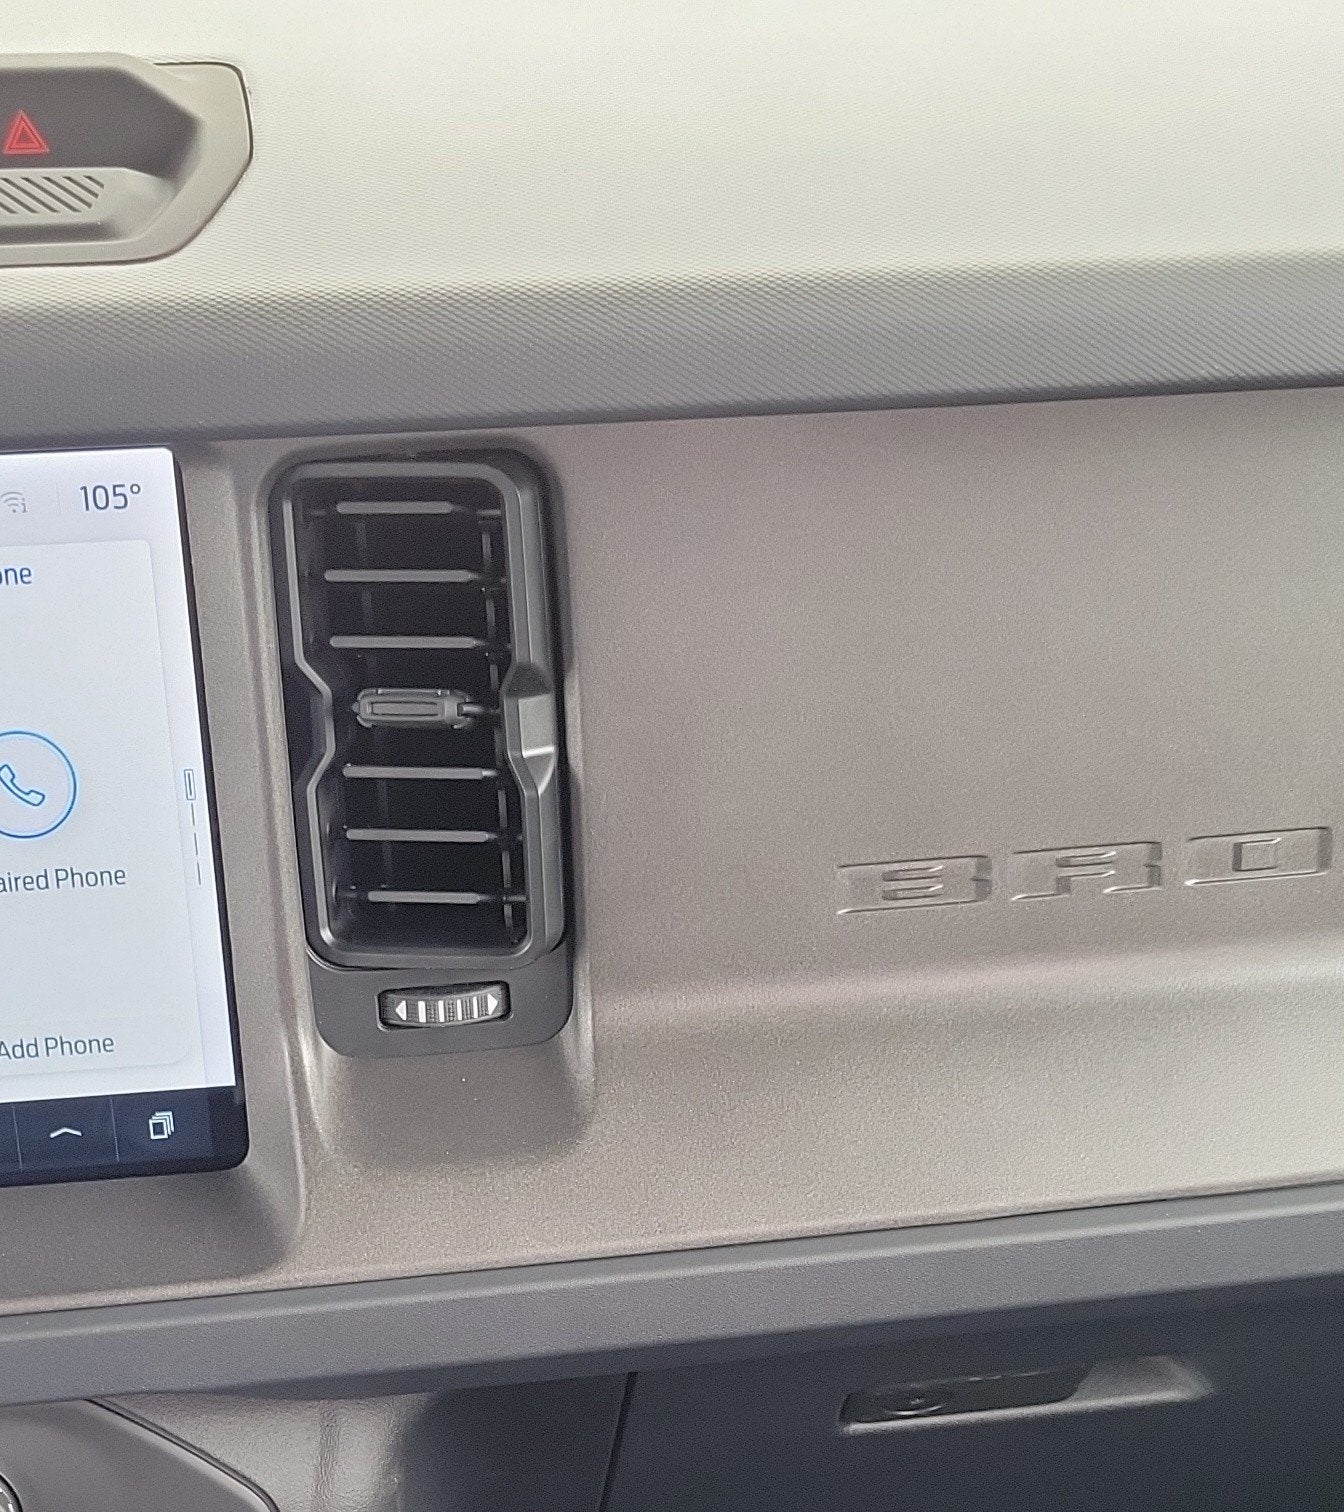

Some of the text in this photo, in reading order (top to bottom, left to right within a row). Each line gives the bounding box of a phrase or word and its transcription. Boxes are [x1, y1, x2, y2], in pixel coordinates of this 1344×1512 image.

[79, 482, 142, 512] 105°
[53, 865, 127, 890] Phone
[45, 1031, 115, 1058] Phone
